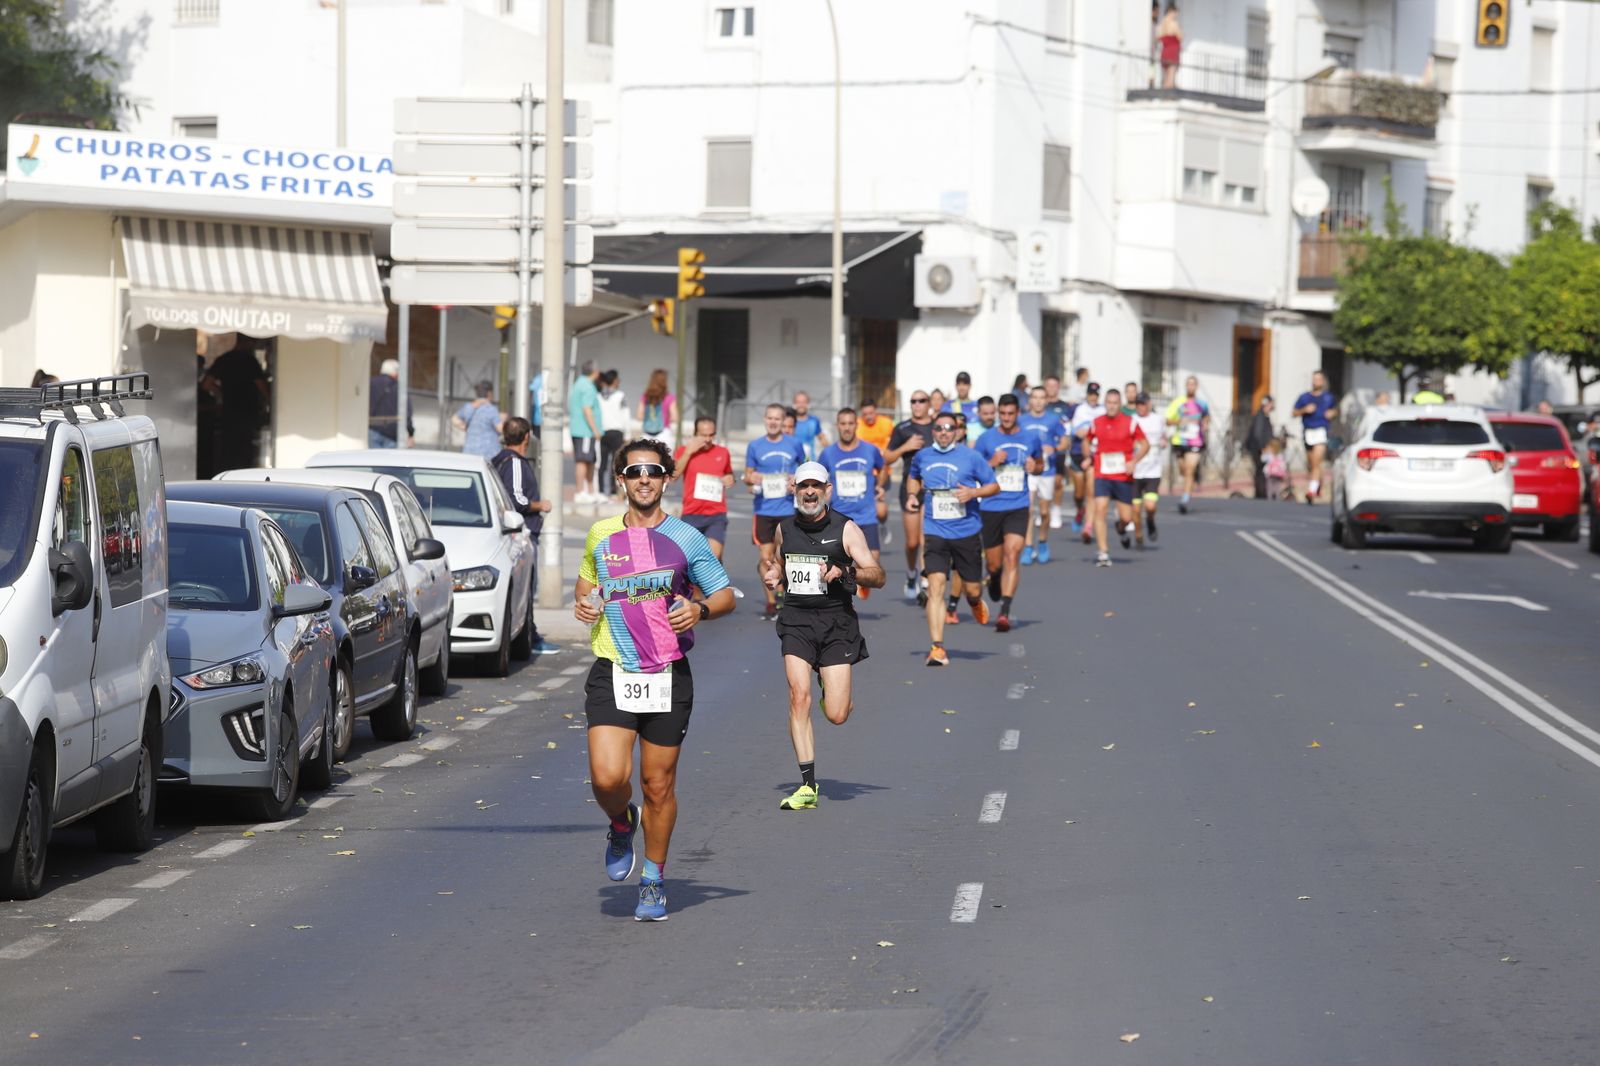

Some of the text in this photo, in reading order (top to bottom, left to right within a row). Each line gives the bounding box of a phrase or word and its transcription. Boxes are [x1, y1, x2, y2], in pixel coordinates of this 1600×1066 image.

[55, 135, 212, 163] CHURROS
[100, 165, 374, 199] PATATAS FRITAS
[144, 305, 291, 332] TOLDOS ONUTAPI
[791, 570, 811, 584] 204
[624, 683, 649, 699] 391
